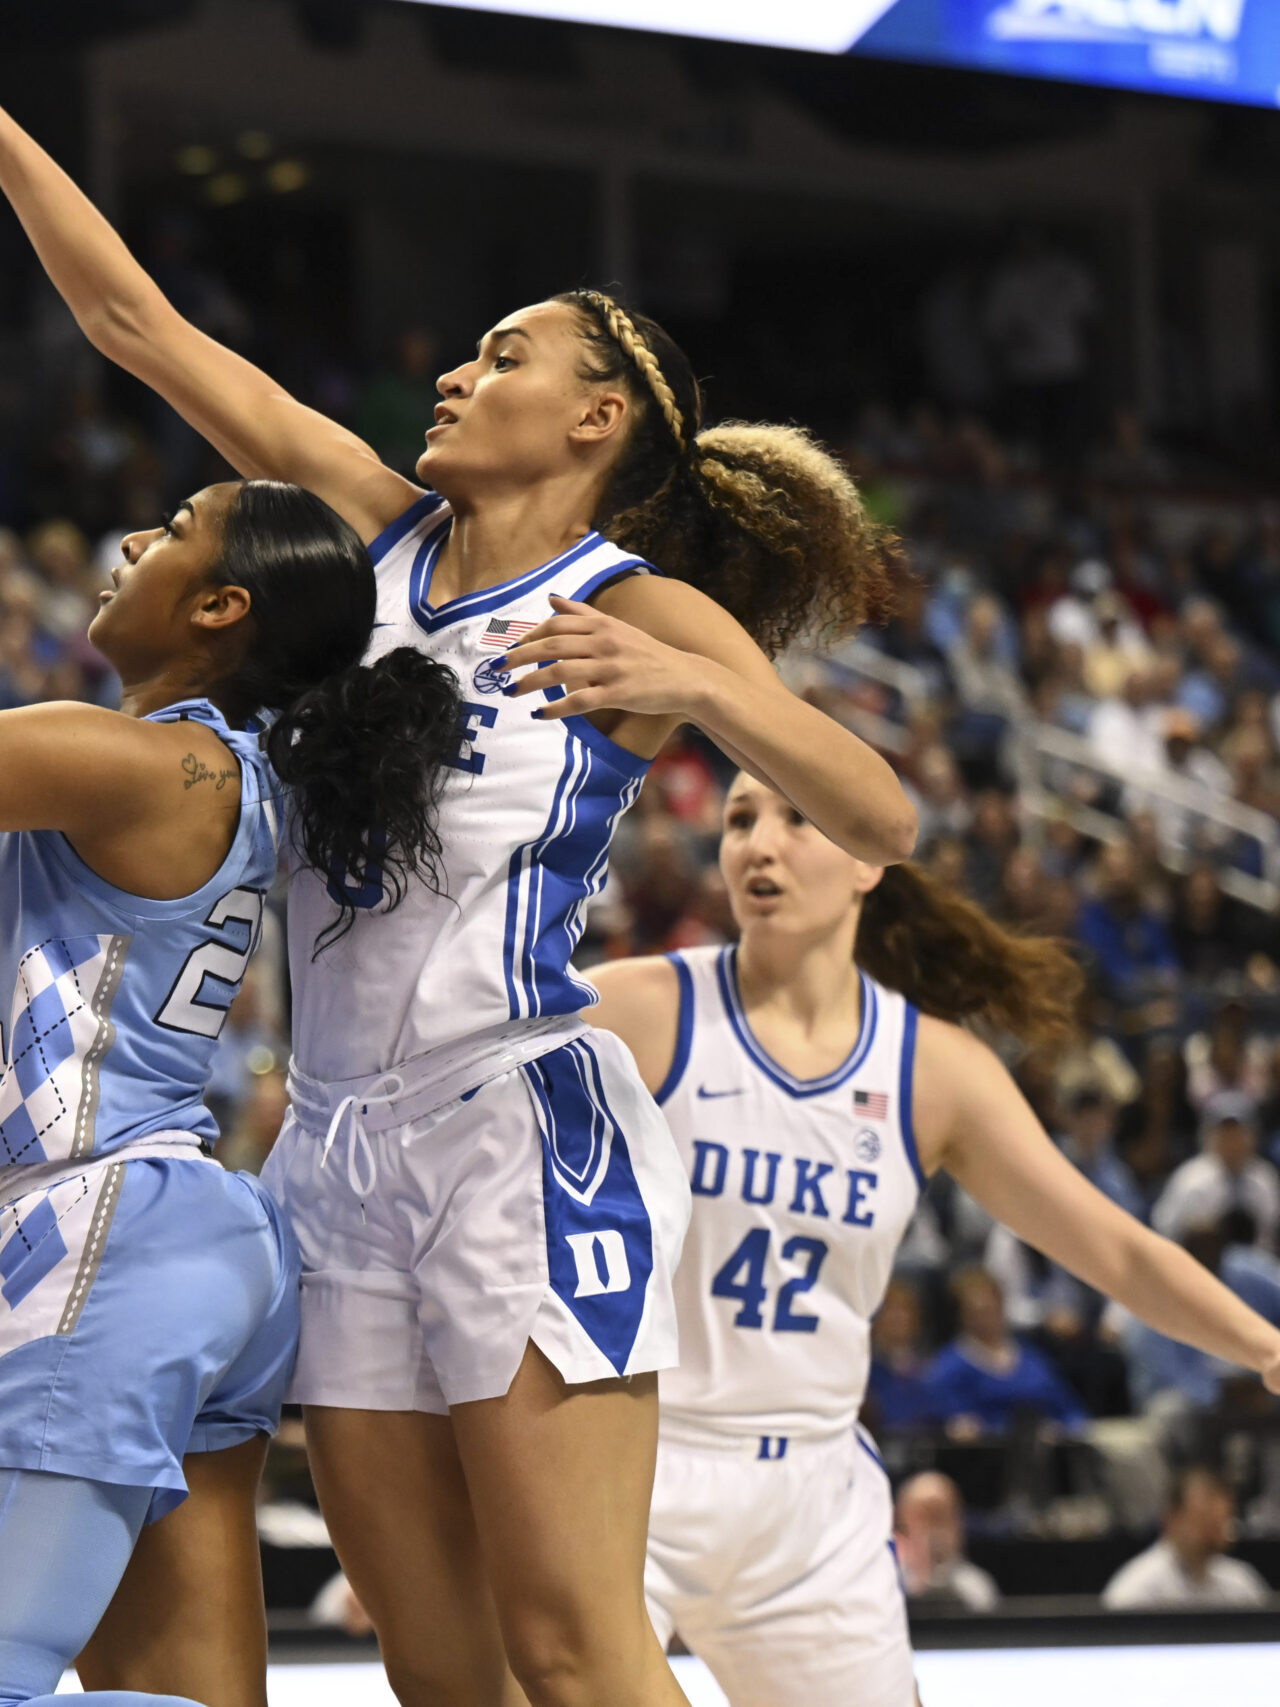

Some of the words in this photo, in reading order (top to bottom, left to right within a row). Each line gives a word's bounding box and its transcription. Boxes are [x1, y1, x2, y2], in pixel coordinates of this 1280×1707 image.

[691, 1139, 878, 1229] DUKE
[564, 1229, 632, 1299] D
[710, 1227, 829, 1334] 42
